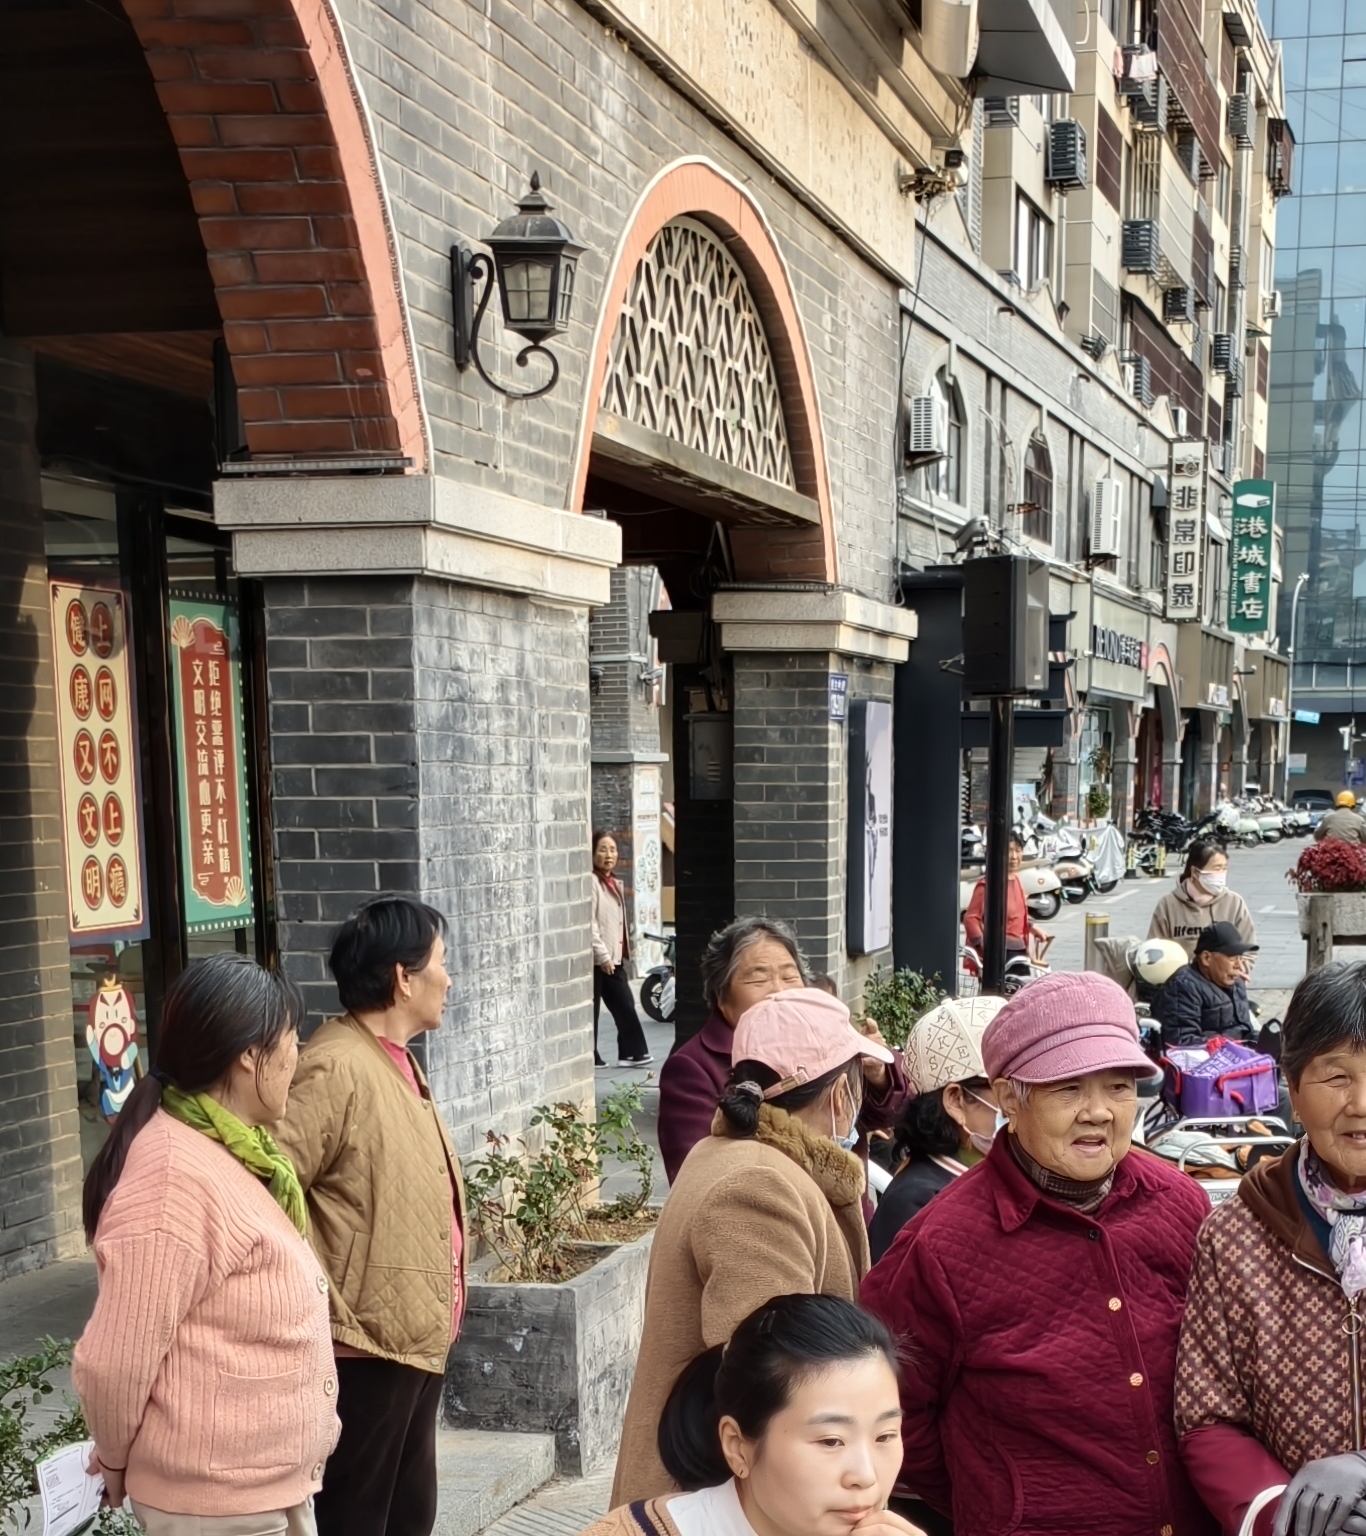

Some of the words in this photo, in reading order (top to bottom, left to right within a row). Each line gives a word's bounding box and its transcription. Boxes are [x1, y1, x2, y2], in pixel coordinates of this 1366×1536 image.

[1172, 486, 1198, 608] 非常印象
[1237, 516, 1269, 620] 港城書店
[69, 608, 102, 898] 健康又文明
[94, 610, 127, 898] 上网不上瘾
[192, 659, 214, 866] 文明交流心更亲
